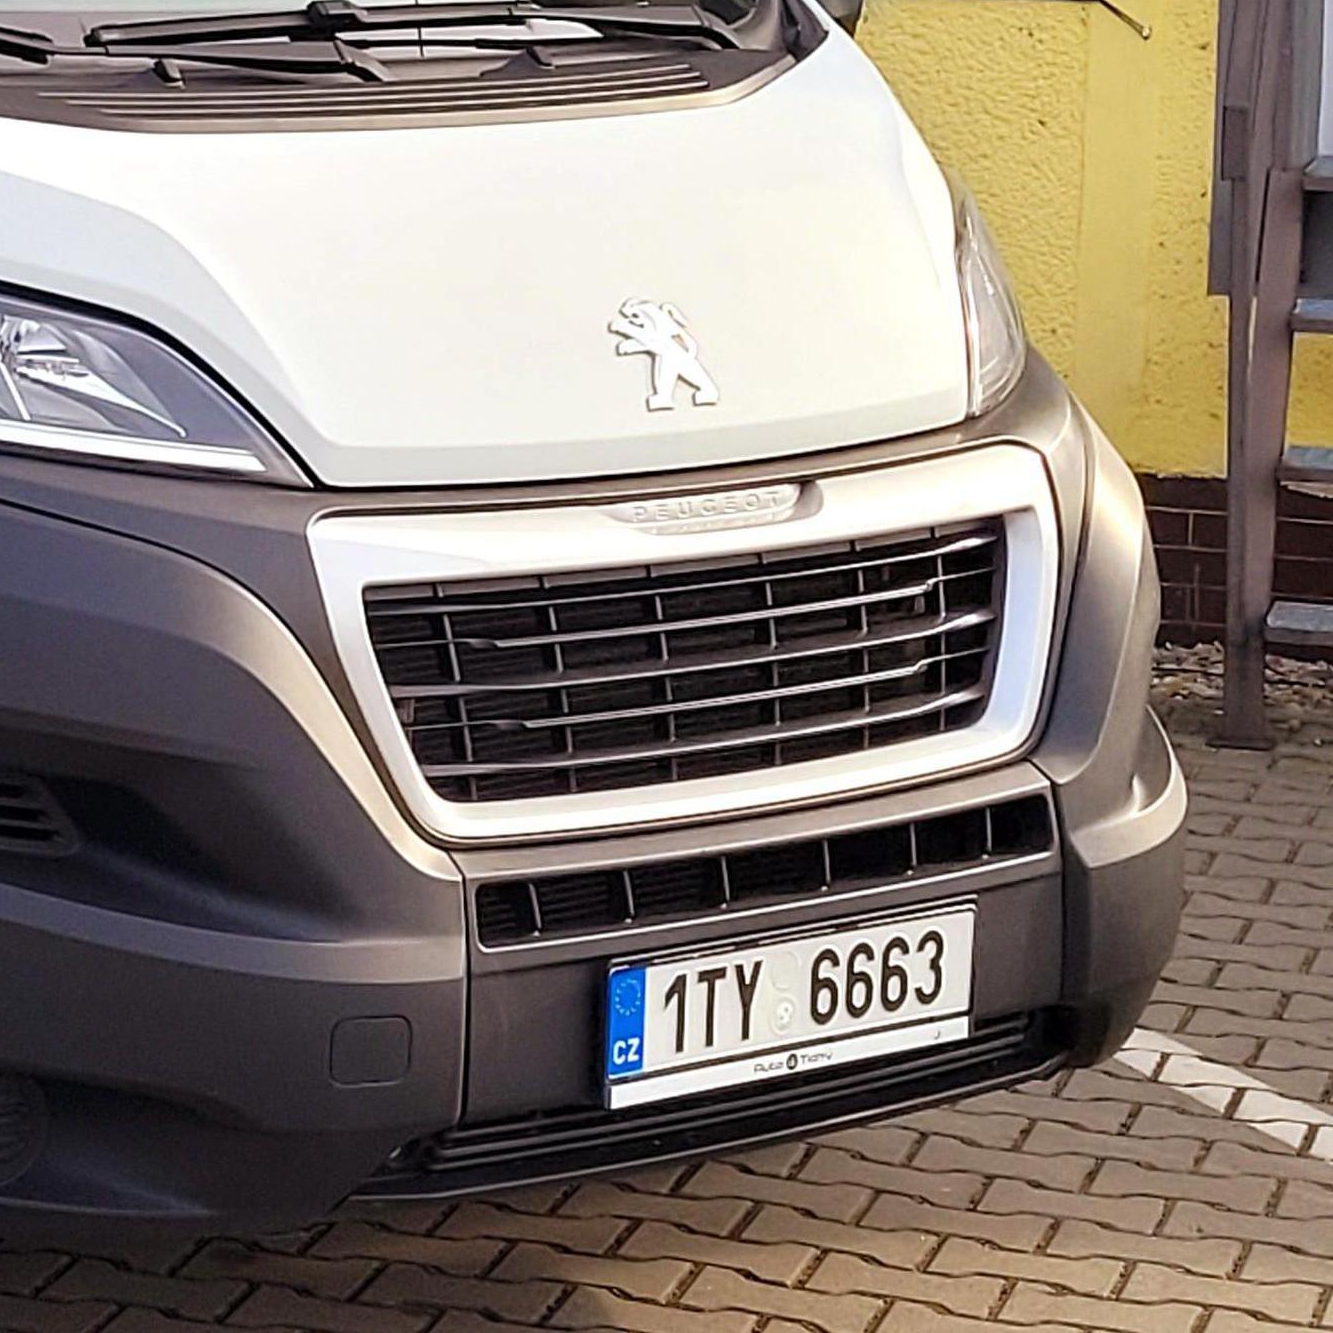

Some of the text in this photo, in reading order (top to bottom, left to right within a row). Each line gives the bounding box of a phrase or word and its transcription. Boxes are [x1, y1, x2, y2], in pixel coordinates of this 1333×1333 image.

[632, 490, 783, 522] PEUGEOT
[664, 929, 945, 1053] 1TY 6663
[612, 1037, 640, 1065] CZ
